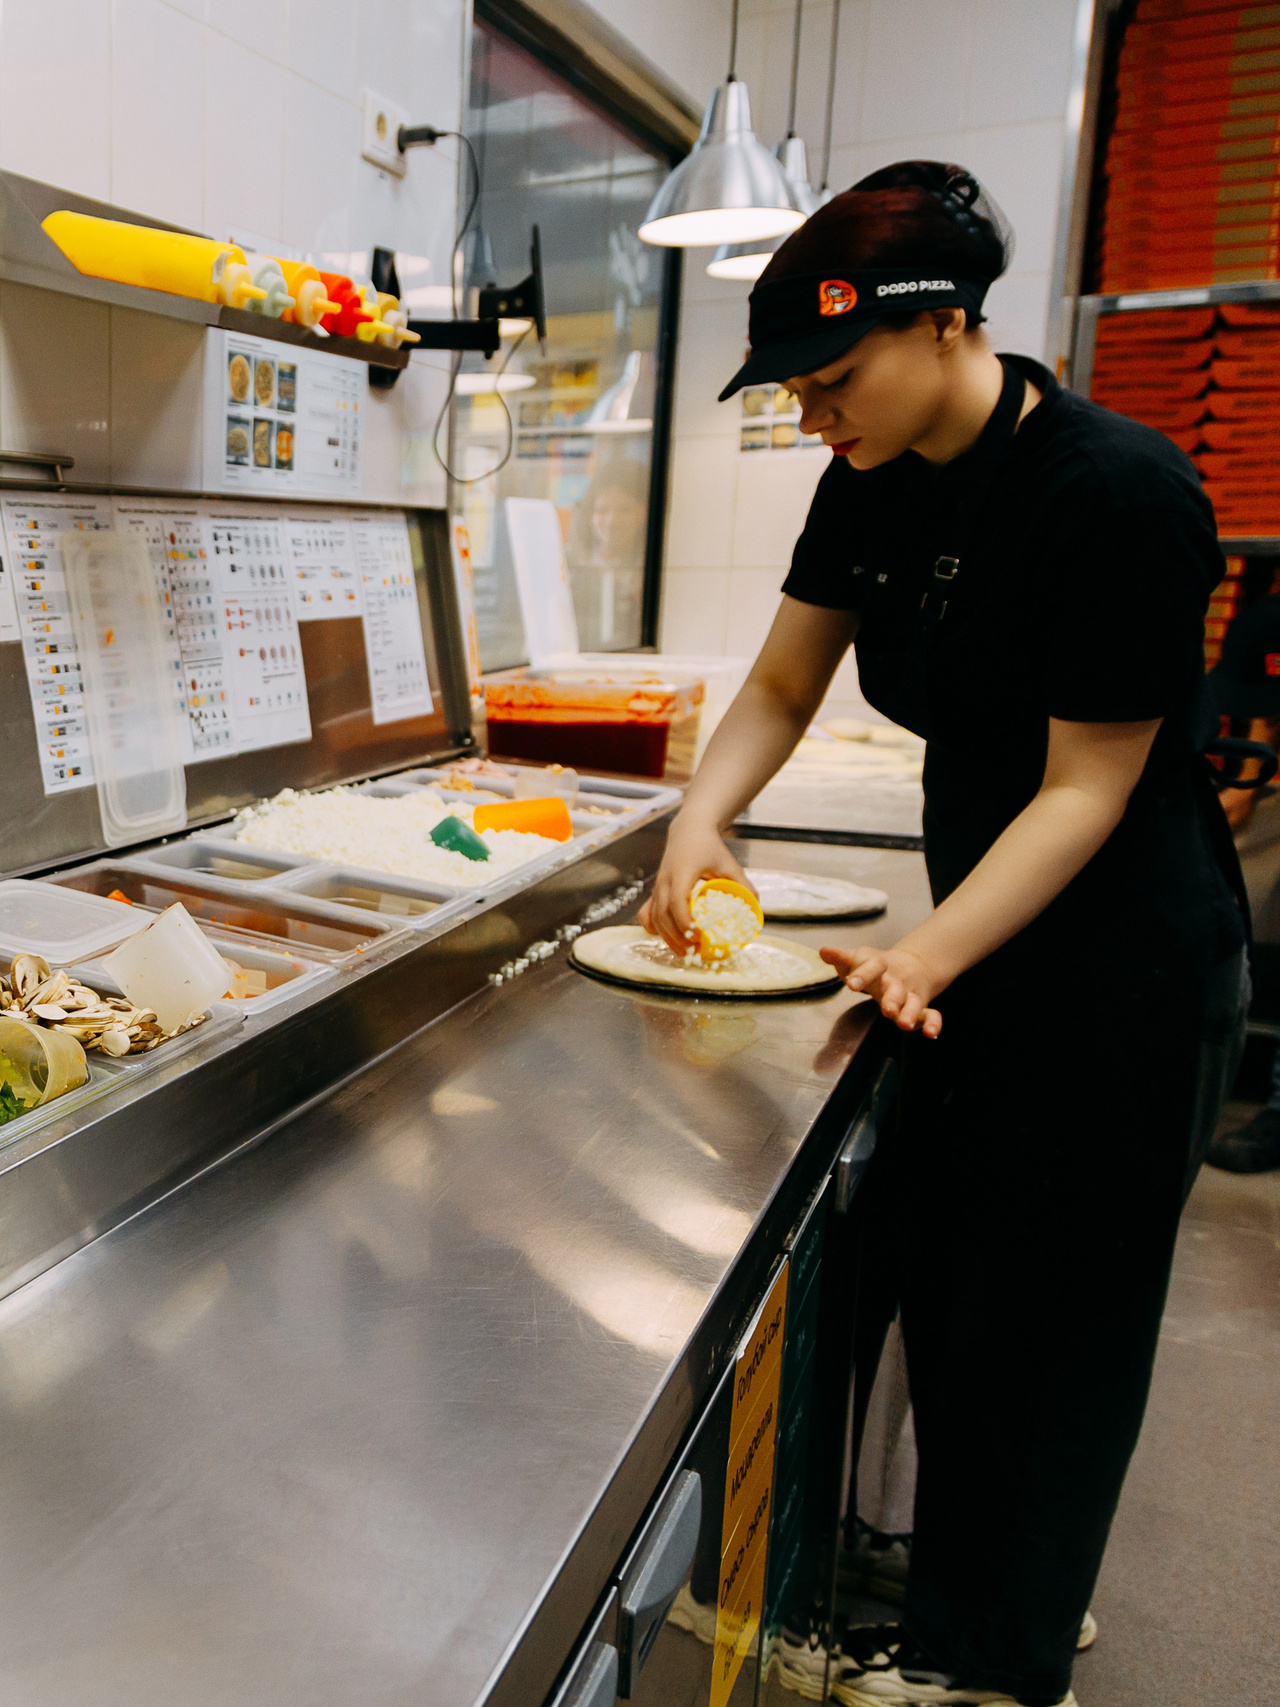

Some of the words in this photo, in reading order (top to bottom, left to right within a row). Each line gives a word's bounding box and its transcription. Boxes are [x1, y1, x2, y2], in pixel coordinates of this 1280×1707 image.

[876, 281, 918, 297] DODO
[919, 279, 955, 292] PIZZA
[736, 1324, 768, 1409] Голубой
[767, 1305, 783, 1347] сыр
